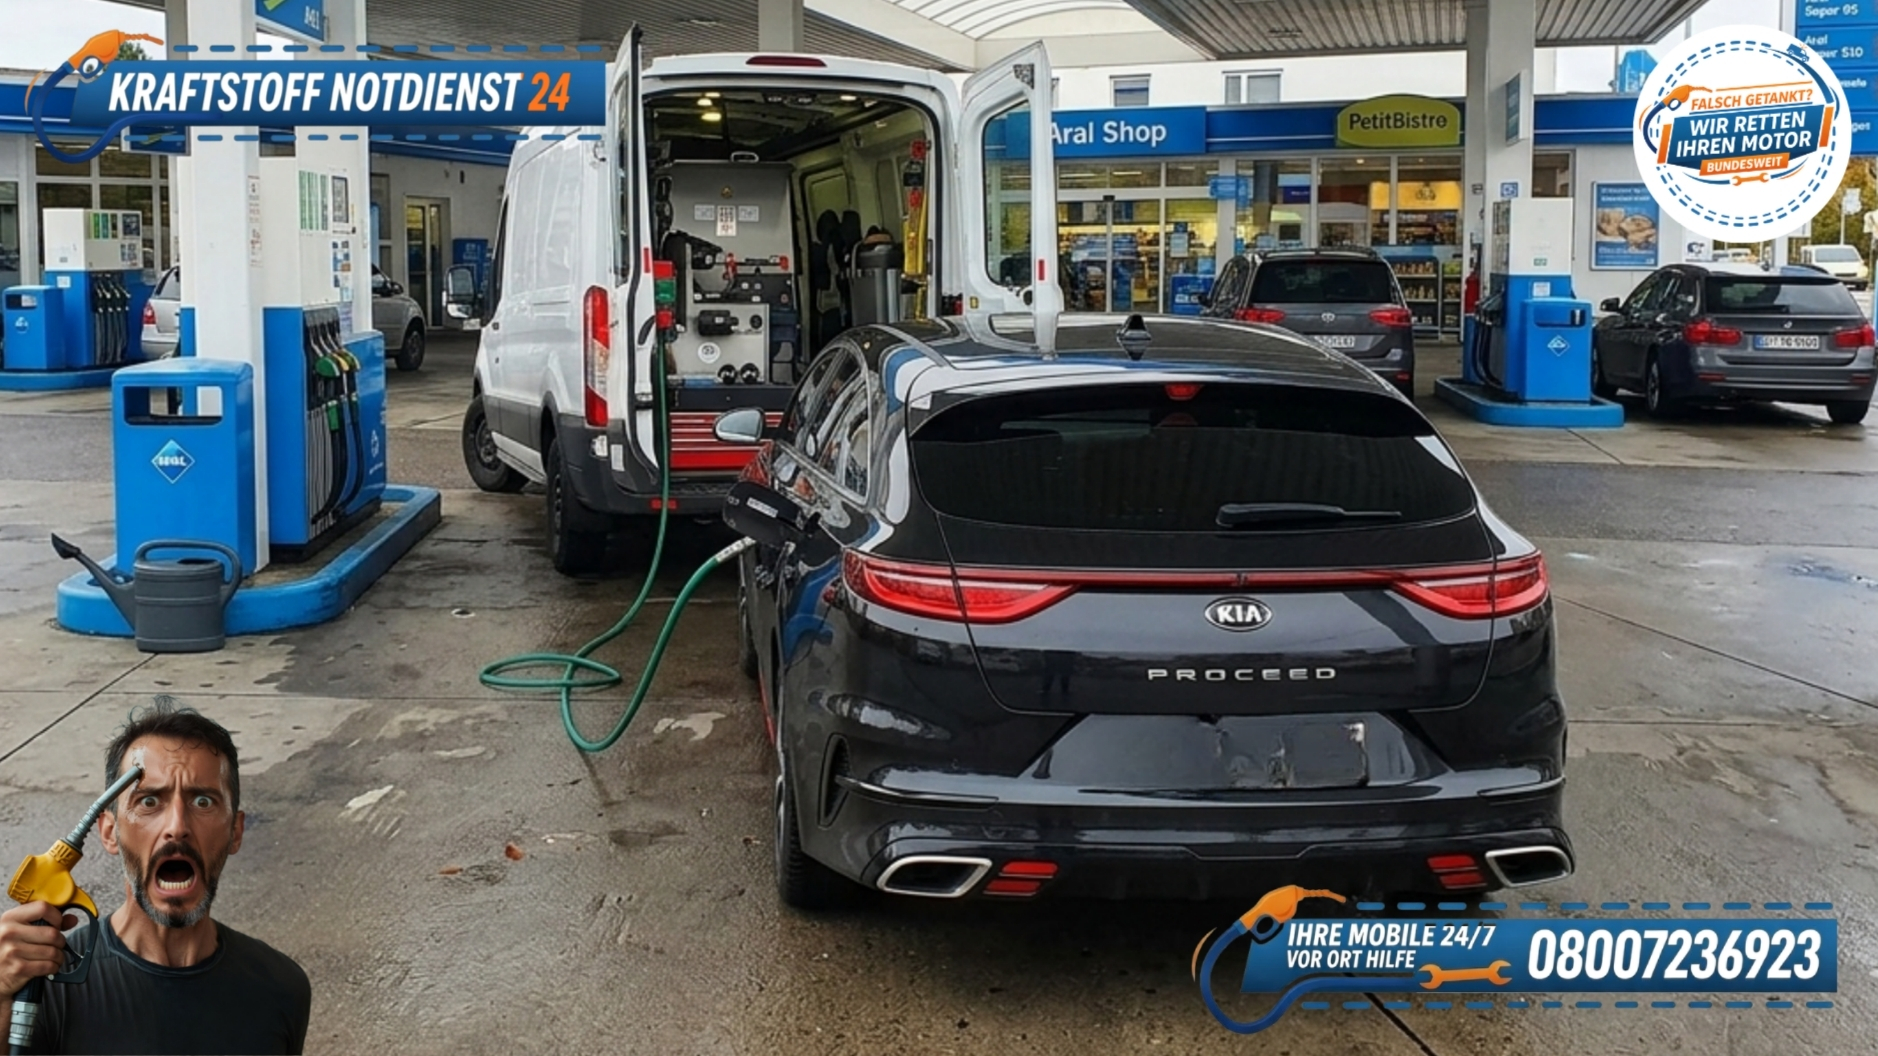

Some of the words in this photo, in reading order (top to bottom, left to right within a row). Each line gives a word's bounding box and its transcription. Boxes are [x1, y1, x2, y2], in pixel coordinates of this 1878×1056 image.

[1051, 121, 1094, 145] Aral
[1102, 120, 1167, 148] Shop
[1217, 605, 1262, 623] KIA
[1147, 668, 1336, 681] PROCEED
